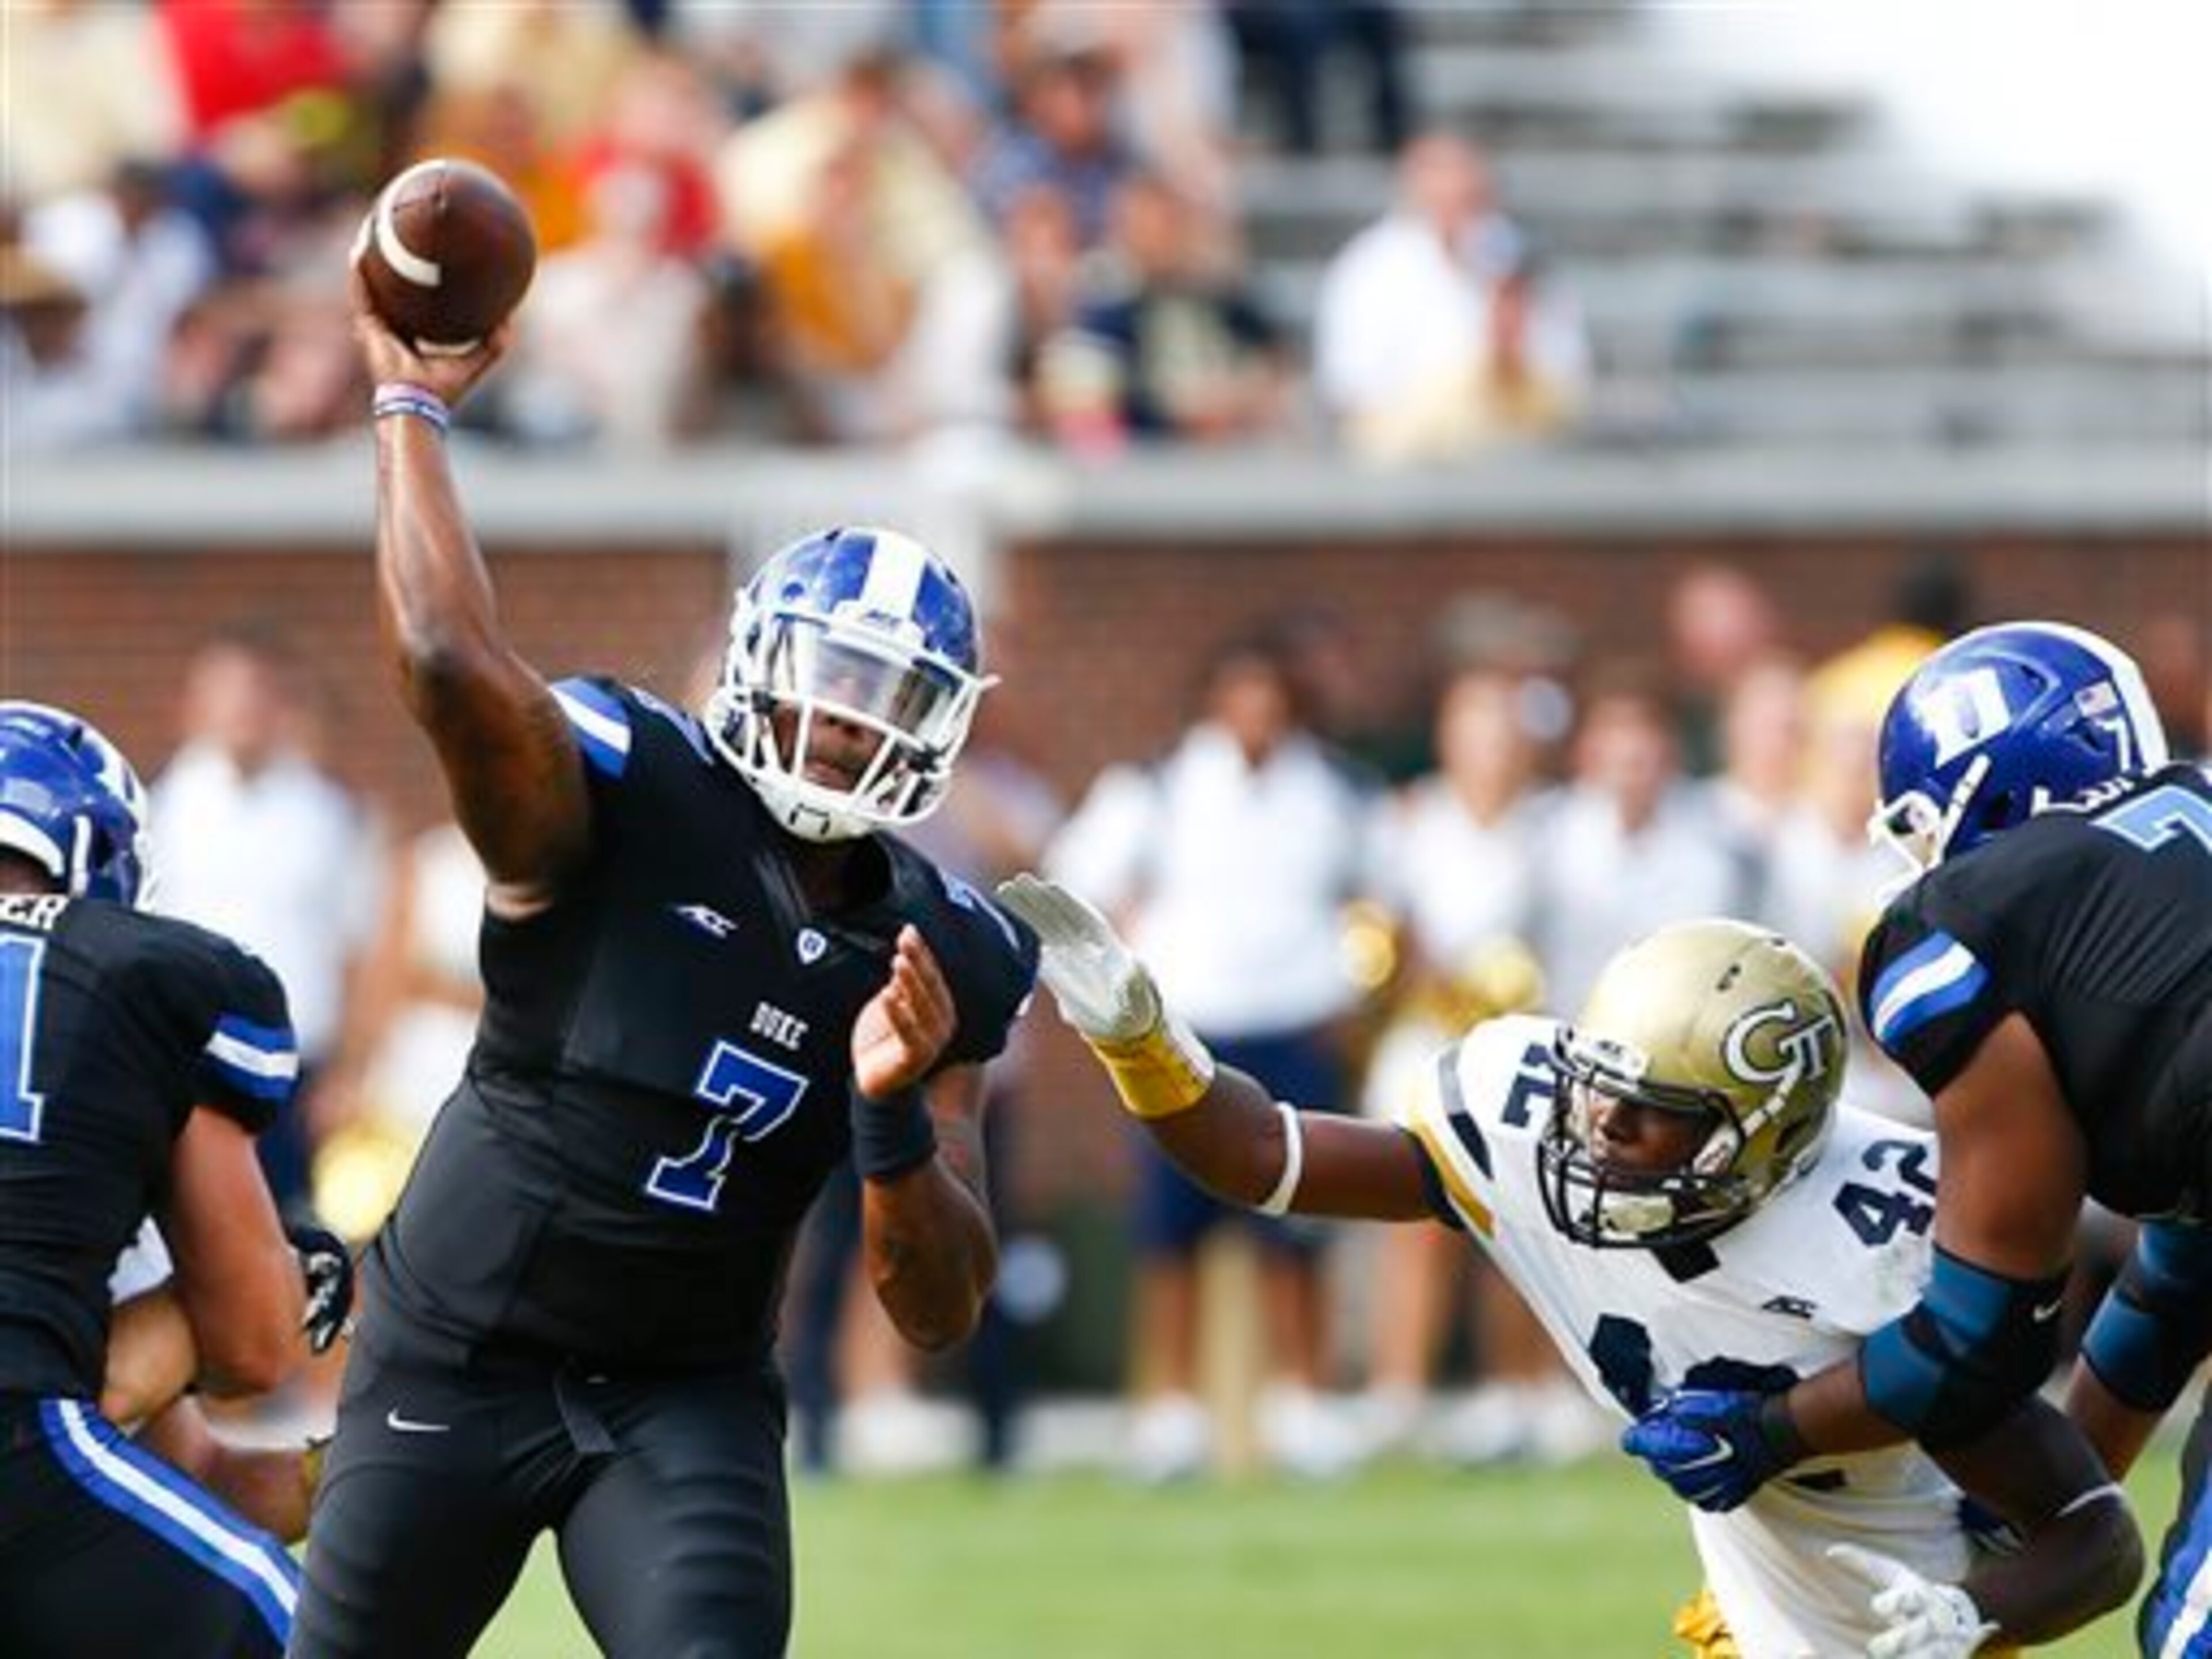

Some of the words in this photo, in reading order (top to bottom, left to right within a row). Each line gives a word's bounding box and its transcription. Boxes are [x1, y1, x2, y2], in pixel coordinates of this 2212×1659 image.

[749, 1001, 809, 1050] DUKE
[645, 1039, 810, 1211] 7
[1832, 1139, 1938, 1248] 42
